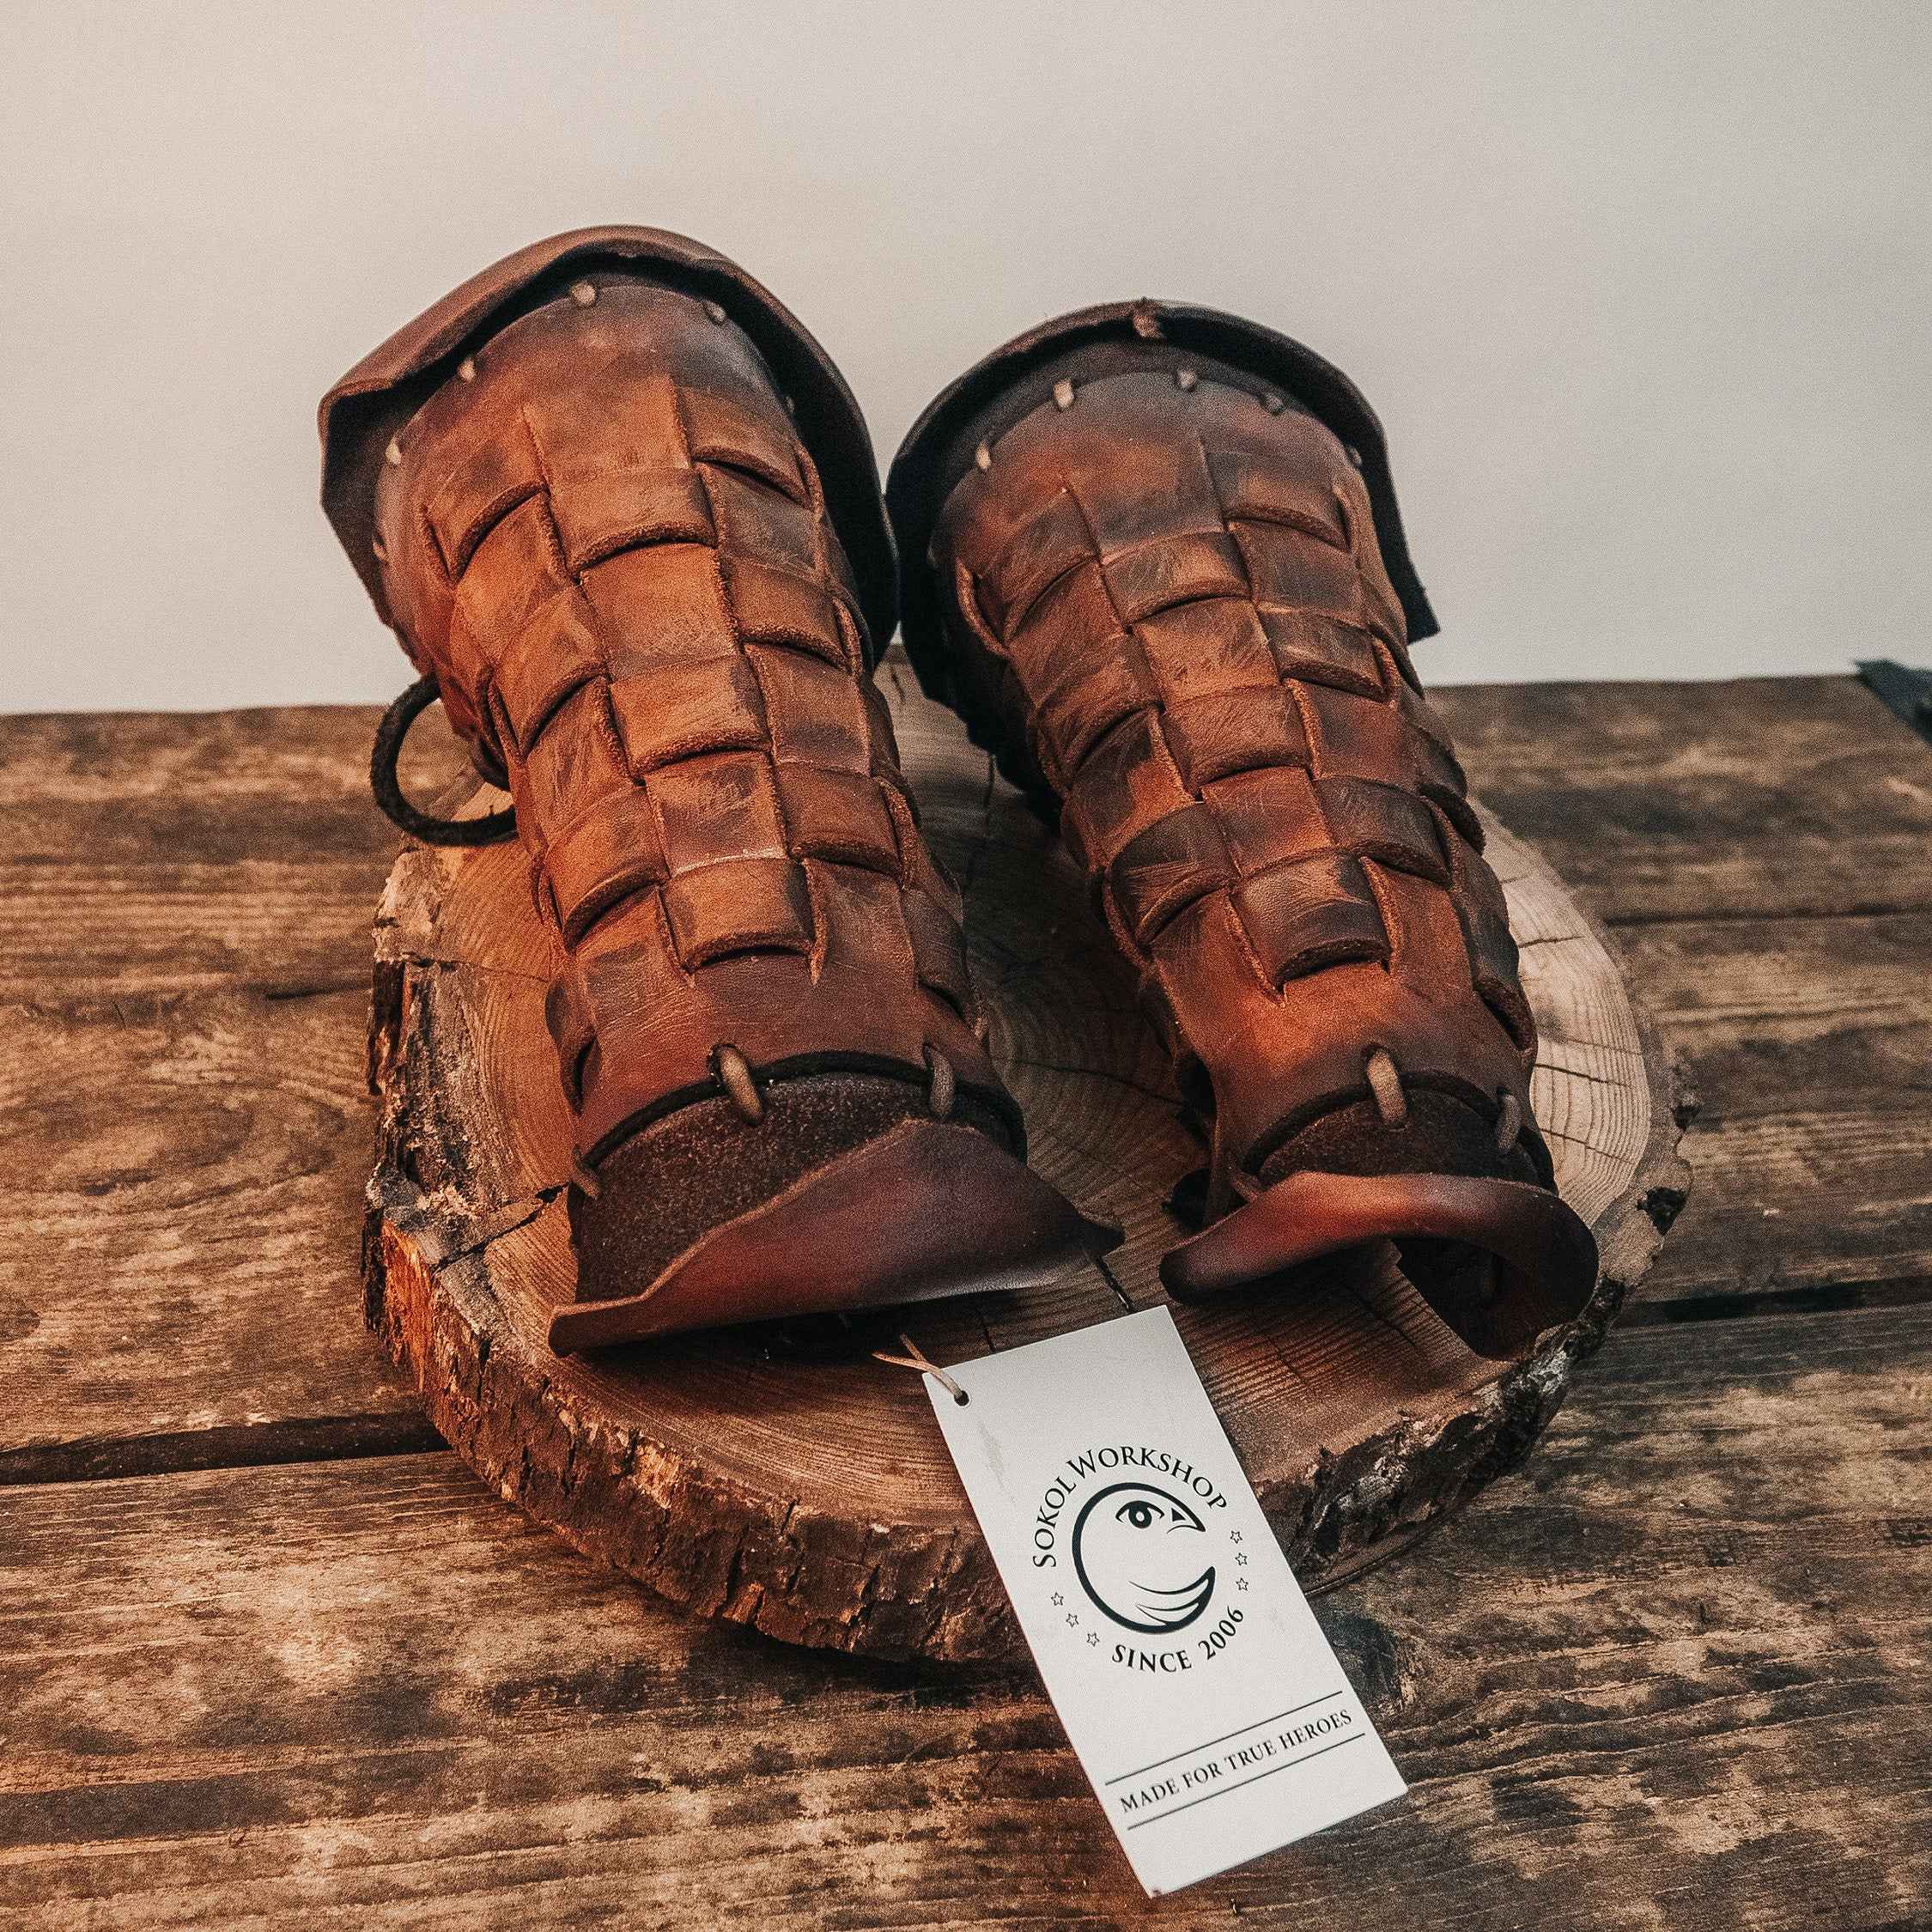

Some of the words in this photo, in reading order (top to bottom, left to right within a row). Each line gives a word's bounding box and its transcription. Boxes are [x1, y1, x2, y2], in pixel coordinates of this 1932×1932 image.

[1032, 1476, 1077, 1567] SOKOL
[1066, 1446, 1227, 1510] WORKSHOP
[1112, 1644, 1192, 1673] SINCE
[1198, 1606, 1243, 1660] 2006
[1120, 1777, 1180, 1813] MADE
[1183, 1762, 1223, 1789] FOR
[1224, 1740, 1277, 1771] TRUE
[1279, 1709, 1352, 1750] HEROES
